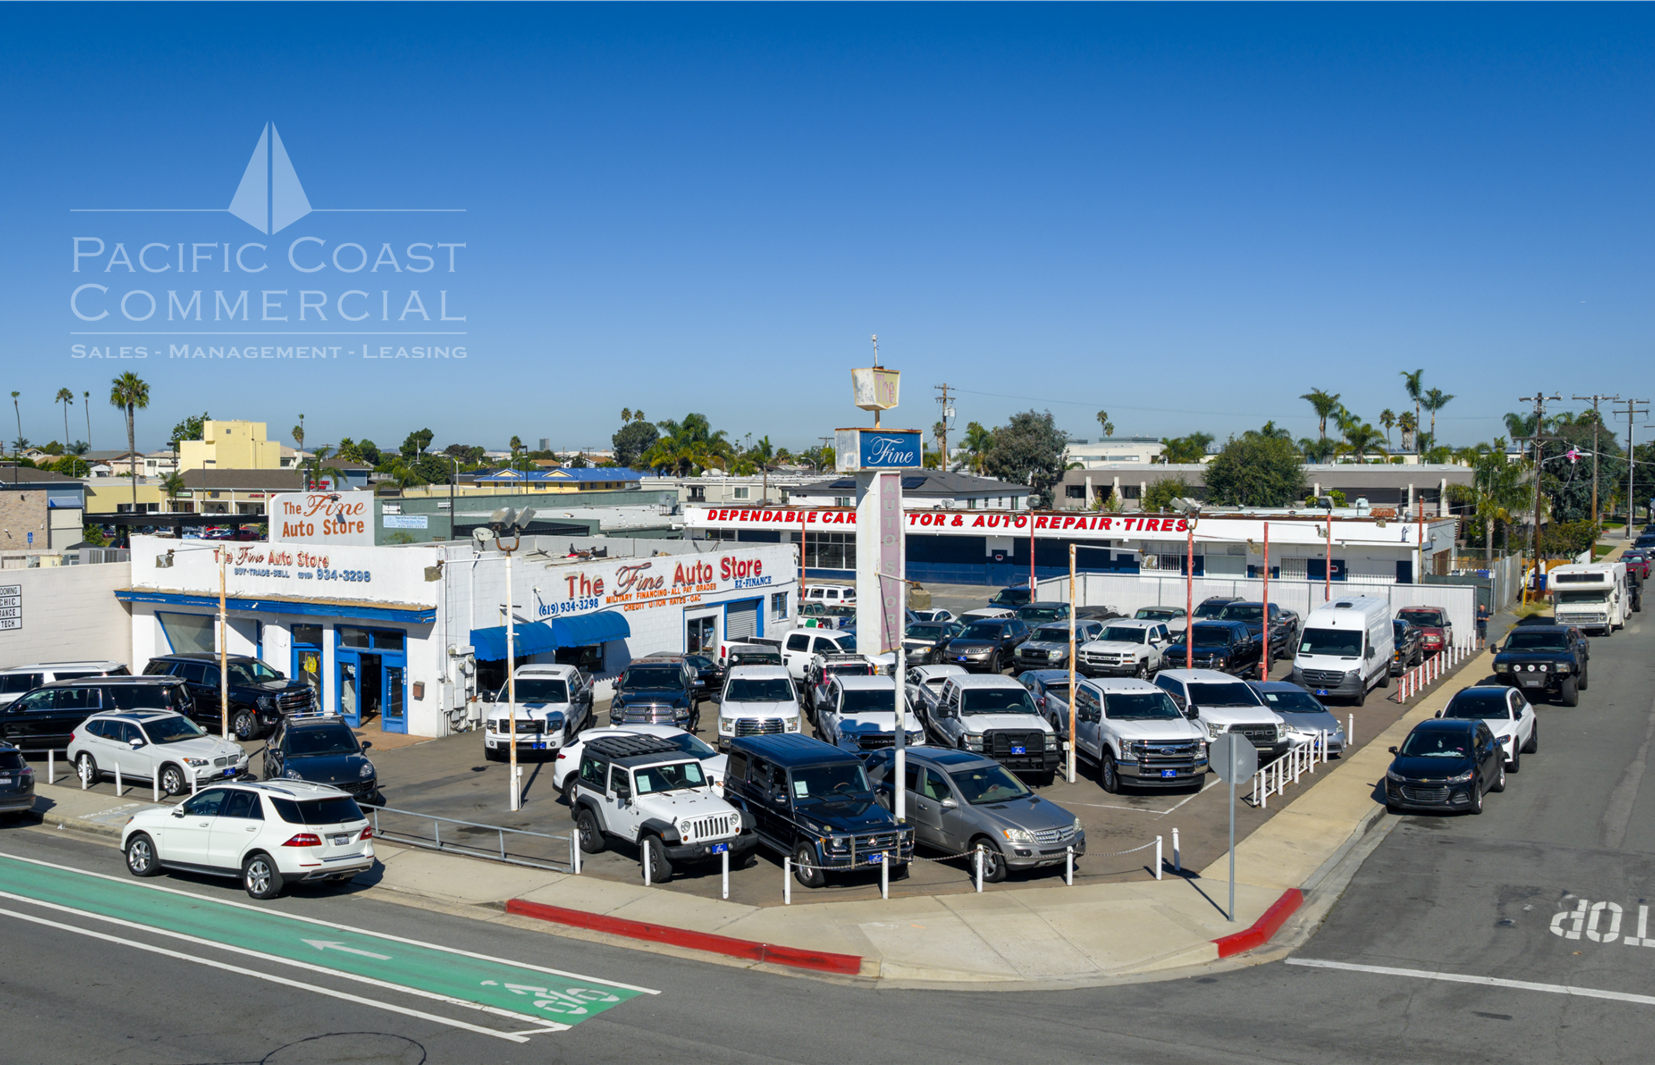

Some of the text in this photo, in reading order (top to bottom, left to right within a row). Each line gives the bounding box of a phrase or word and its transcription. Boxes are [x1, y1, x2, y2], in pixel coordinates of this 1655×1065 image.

[875, 373, 895, 403] The
[867, 436, 914, 464] Fine
[282, 493, 368, 517] The Fine
[282, 518, 365, 538] Auto Store
[707, 509, 818, 524] DEPENDABLE
[951, 514, 963, 527] &
[972, 515, 1028, 529] AUTO
[1035, 516, 1113, 530] REPAIR
[1123, 517, 1189, 532] TIRES
[213, 549, 233, 565] Te
[268, 550, 294, 567] Auto
[297, 551, 330, 569] Store
[883, 481, 897, 645] AUTO STORE
[317, 568, 372, 583] 934-3298
[563, 555, 763, 599] The Fine Auto Store
[606, 593, 633, 604] MILITARY
[683, 585, 692, 594] PAY
[695, 583, 717, 592] GRADES
[538, 598, 599, 617] (619) 934-3298
[623, 602, 645, 612] CREDIT
[1, 620, 15, 628] TECH
